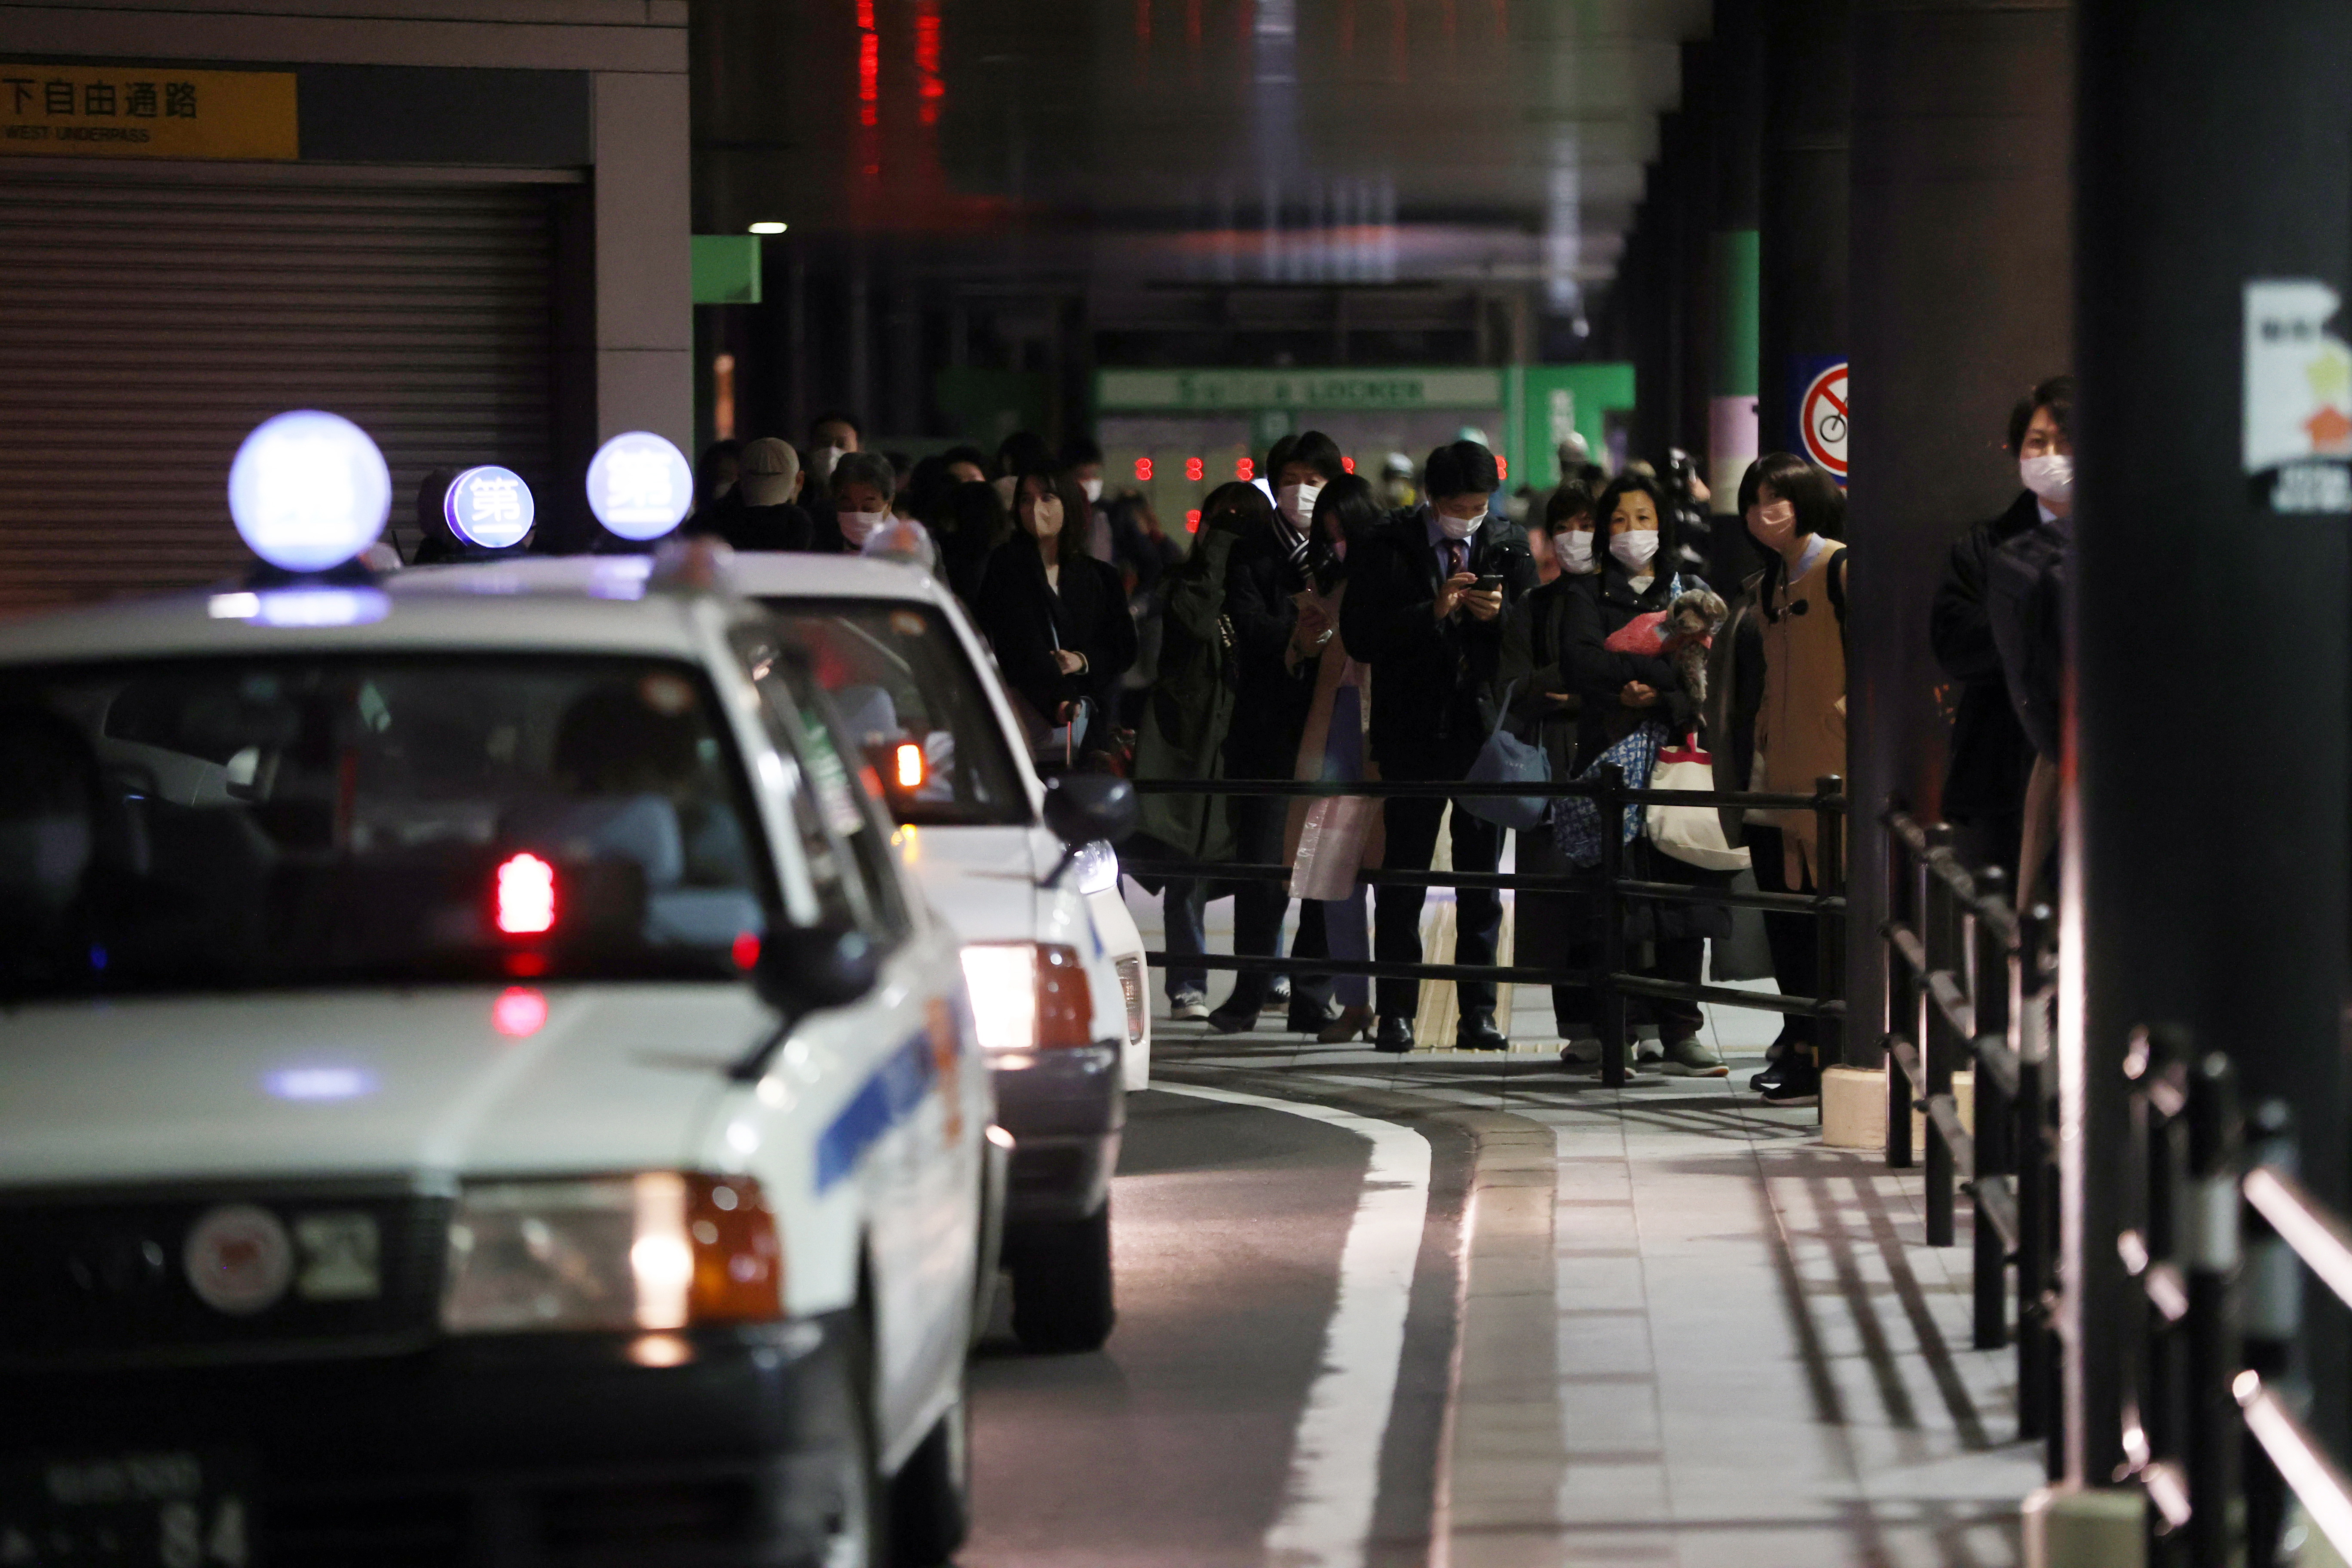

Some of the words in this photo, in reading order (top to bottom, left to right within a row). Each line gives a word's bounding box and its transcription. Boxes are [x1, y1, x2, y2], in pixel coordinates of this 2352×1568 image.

[2, 78, 196, 119] 下自由通路
[6, 125, 49, 140] WEST
[56, 126, 150, 143] UNDERPASS
[1309, 380, 1424, 400] LOCKER
